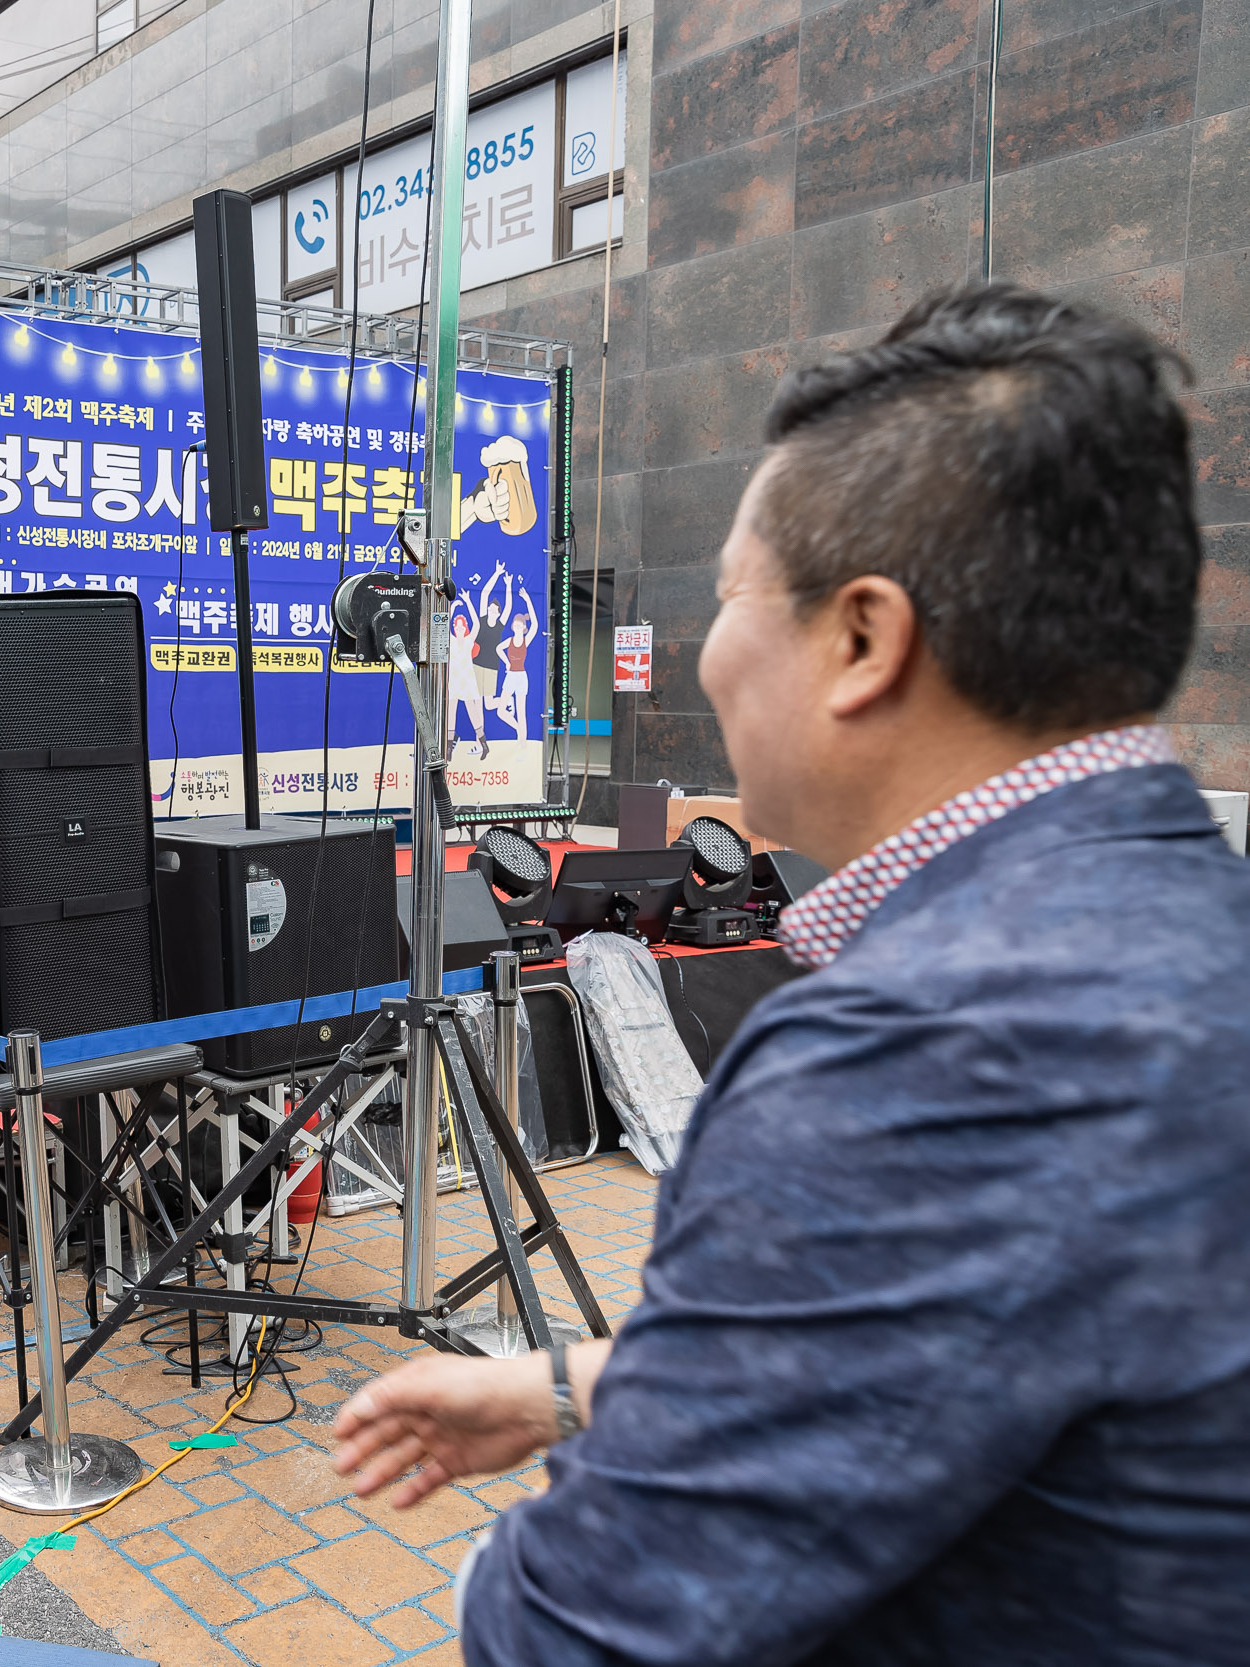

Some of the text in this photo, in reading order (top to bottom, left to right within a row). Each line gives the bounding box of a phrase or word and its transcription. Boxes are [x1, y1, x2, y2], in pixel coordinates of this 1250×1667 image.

[23, 394, 72, 423] 제2회
[80, 401, 154, 431] 맥주축제
[295, 420, 361, 449] 축하공연
[366, 428, 383, 451] 및
[16, 526, 107, 550] 신성전통시장내
[261, 540, 300, 560] 2024년
[304, 542, 323, 560] 6월
[327, 543, 349, 561] 21일
[353, 545, 386, 563] 금요일
[616, 631, 650, 647] 주차금지
[155, 650, 230, 666] 맥주교환권
[180, 780, 229, 801] 행복광진
[271, 772, 359, 794] 신성전통시장
[68, 823, 82, 832] LA
